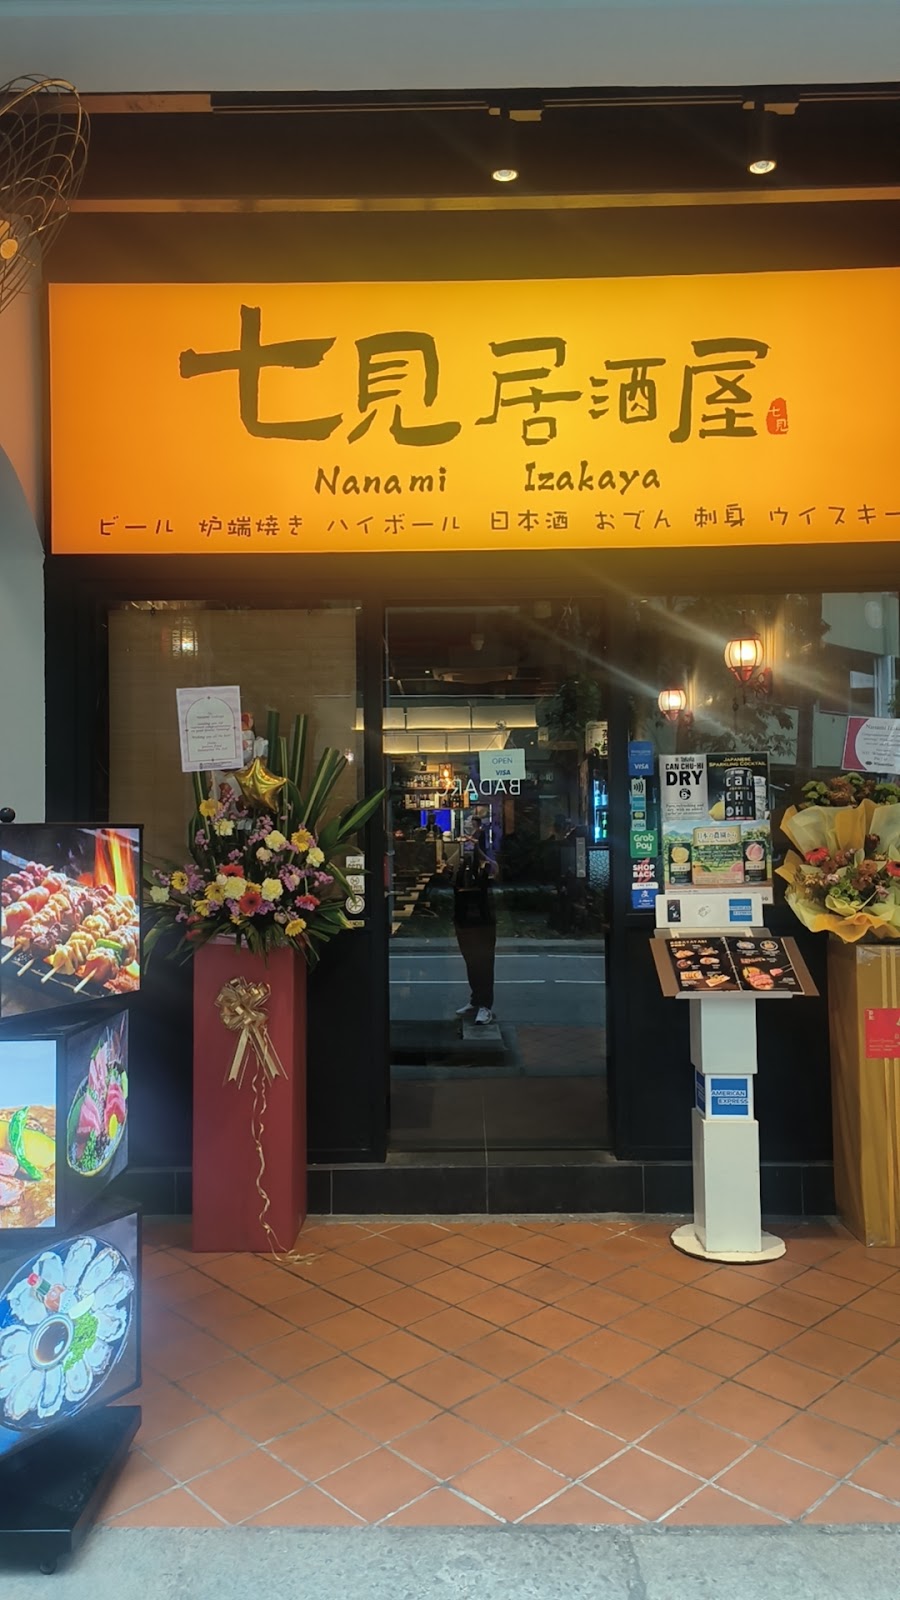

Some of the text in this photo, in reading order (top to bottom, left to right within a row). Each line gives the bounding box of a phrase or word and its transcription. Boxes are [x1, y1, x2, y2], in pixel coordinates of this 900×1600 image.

[179, 304, 771, 446] 七見居酒屋
[769, 406, 789, 432] 七見
[314, 460, 661, 495] Nanami Izakaya
[100, 515, 174, 536] ビール
[199, 515, 303, 537] 炉端焼き
[327, 513, 460, 536] ハイボール
[491, 510, 569, 531] 日本酒
[595, 510, 671, 530] おでん
[695, 503, 745, 528] 刺身
[492, 757, 513, 765] OPEN
[665, 762, 704, 771] CAN CHU-HI
[666, 771, 703, 786] DRY
[633, 833, 655, 842] Grab
[636, 841, 653, 851] Pay
